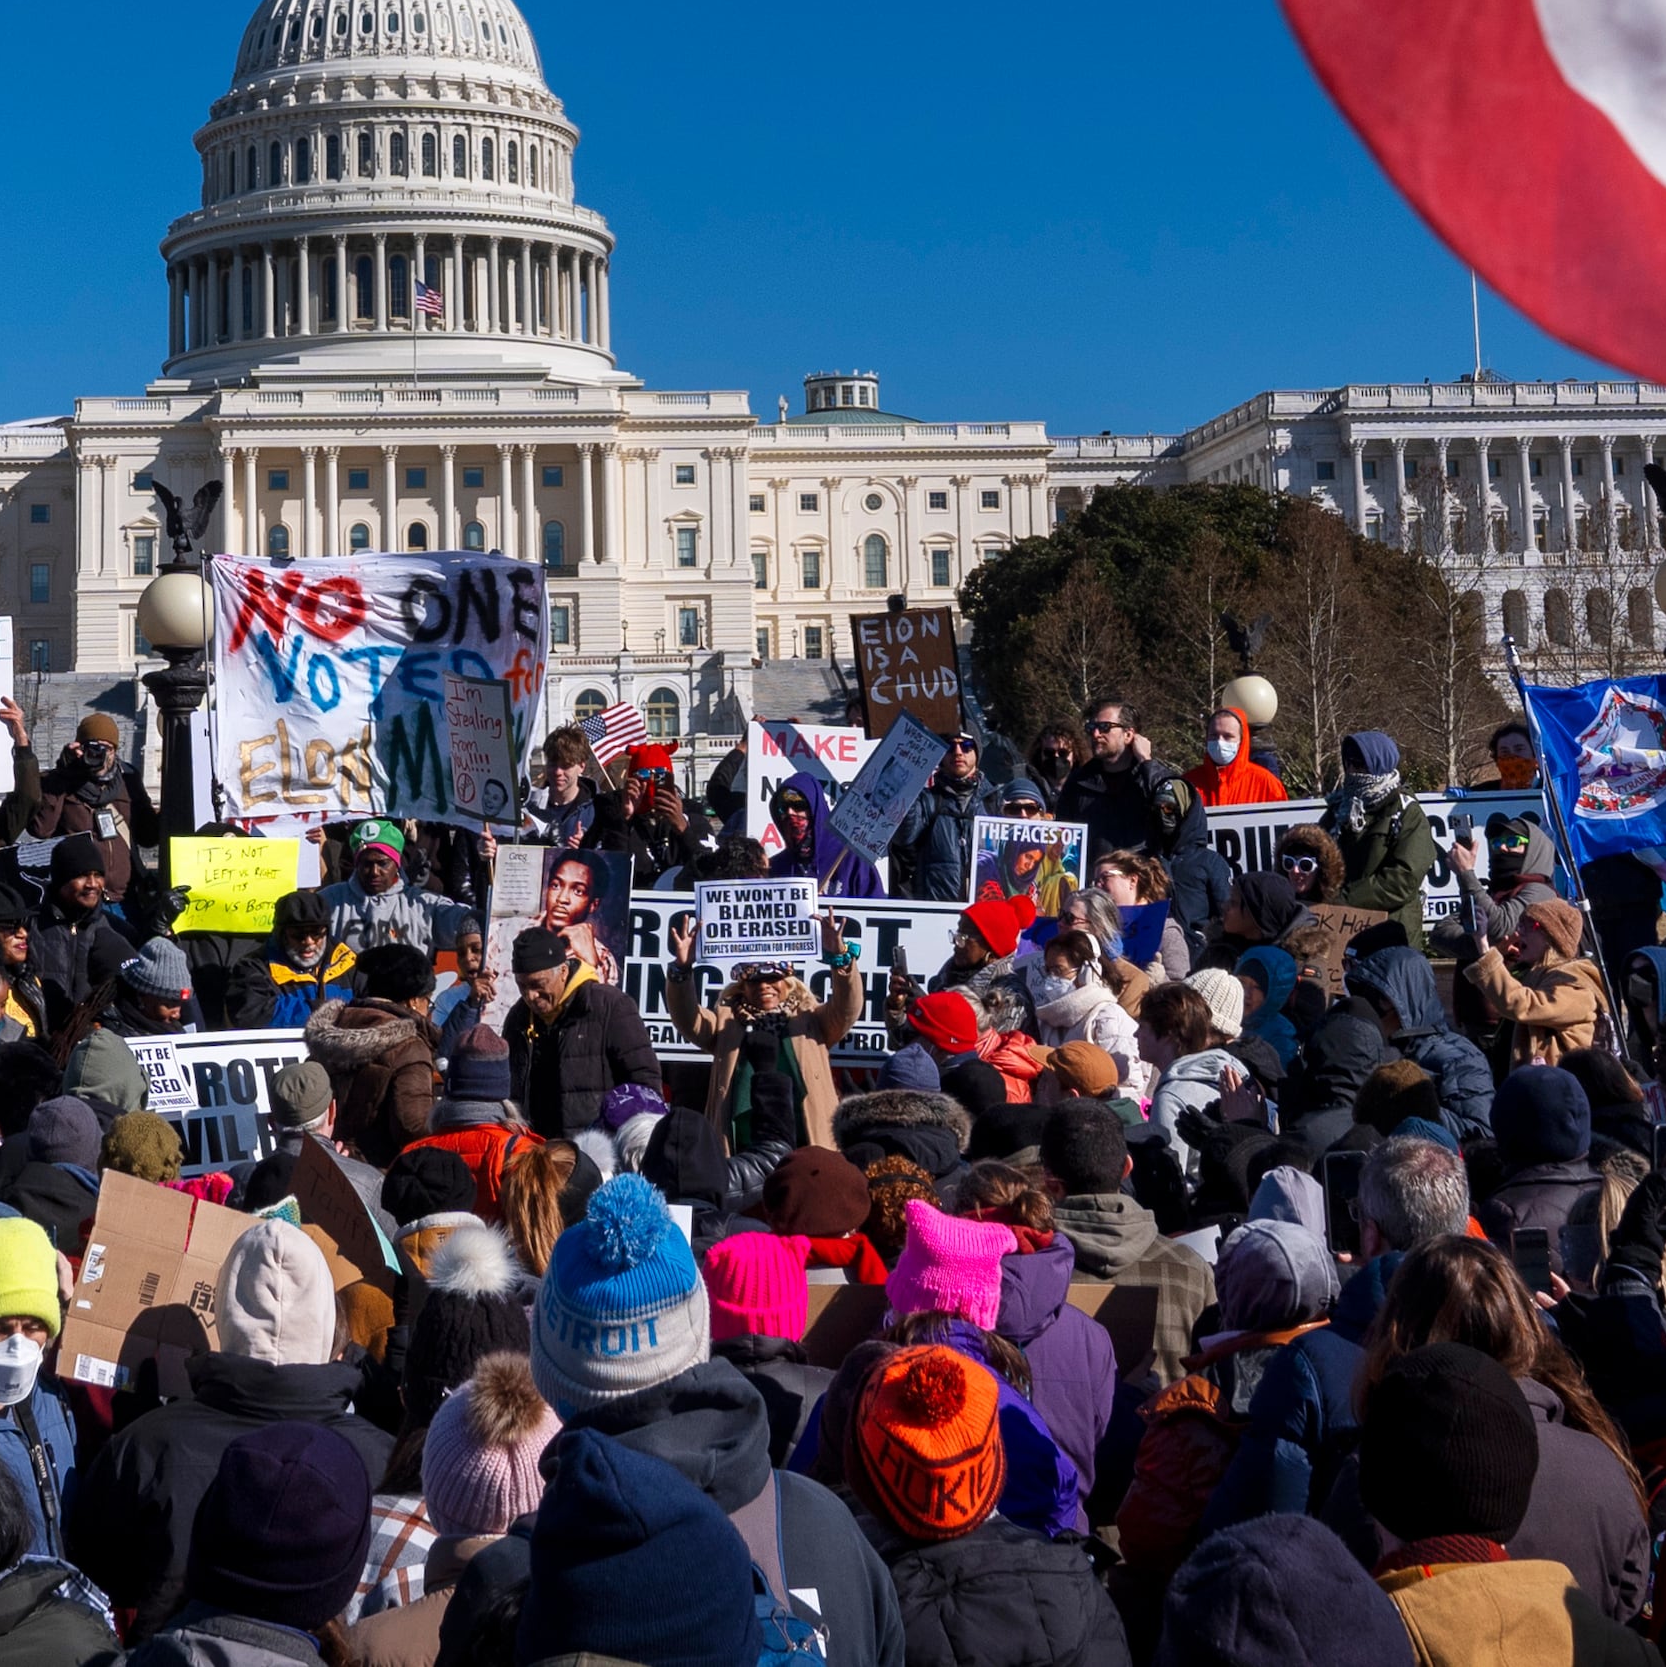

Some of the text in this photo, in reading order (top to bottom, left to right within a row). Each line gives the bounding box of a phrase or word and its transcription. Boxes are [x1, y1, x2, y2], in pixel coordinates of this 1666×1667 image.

[229, 567, 539, 654] NO ONE
[867, 646, 919, 671] IS A
[258, 631, 496, 721] VOTED
[871, 665, 958, 704] CHUD
[446, 702, 502, 740] Stealing
[450, 732, 478, 753] From
[762, 730, 858, 762] MAKE
[240, 718, 371, 810] ELON
[980, 822, 1081, 846] THE FACES OF
[241, 845, 269, 859] NOT
[508, 852, 527, 863] Greg
[205, 868, 238, 883] LEFT
[706, 888, 809, 902] WE WON'T BE
[186, 899, 215, 914] TOP
[719, 903, 797, 920] BLAMED
[706, 920, 811, 939] OR ERASED
[704, 942, 814, 954] PEOPLE'S ORGANIZATION FOR PROGRESS
[156, 1048, 171, 1060] BE
[35, 1445, 48, 1479] Canon
